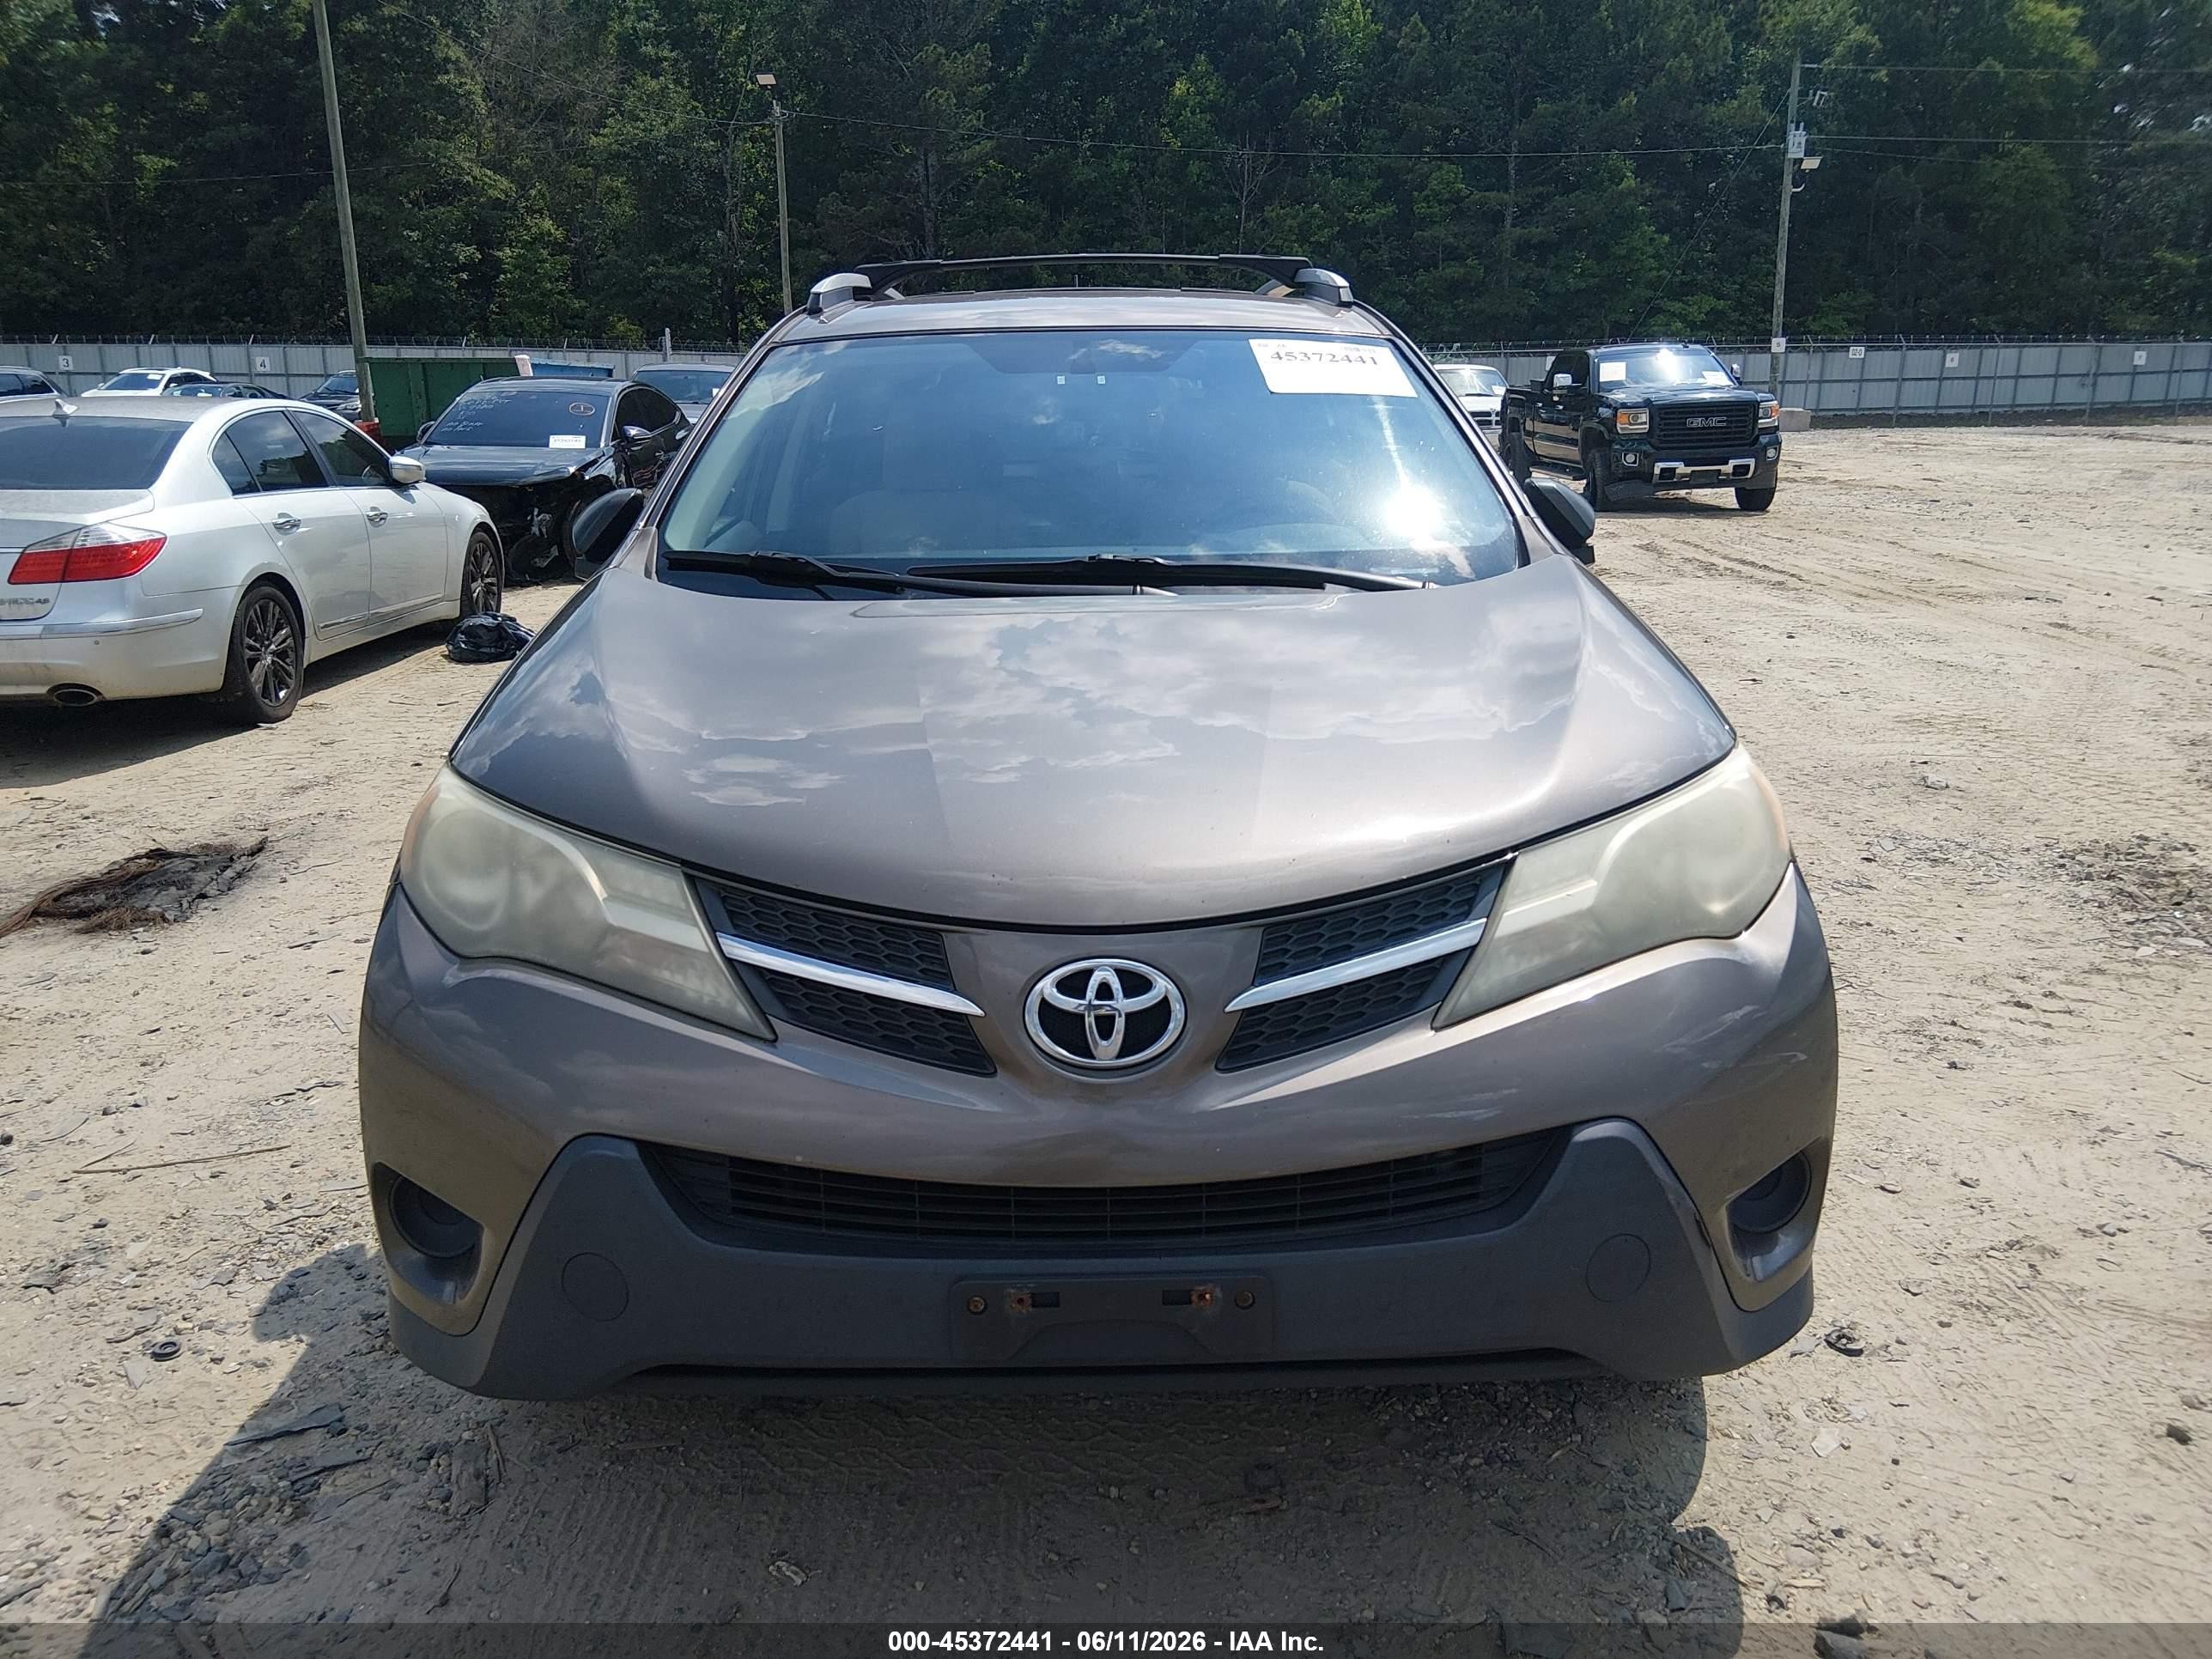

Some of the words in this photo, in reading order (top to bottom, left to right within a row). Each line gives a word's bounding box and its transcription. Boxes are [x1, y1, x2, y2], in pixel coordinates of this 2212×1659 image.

[63, 357, 70, 368] 3
[259, 358, 266, 369] 4
[1270, 350, 1378, 366] 45372441
[1686, 416, 1727, 428] GMC
